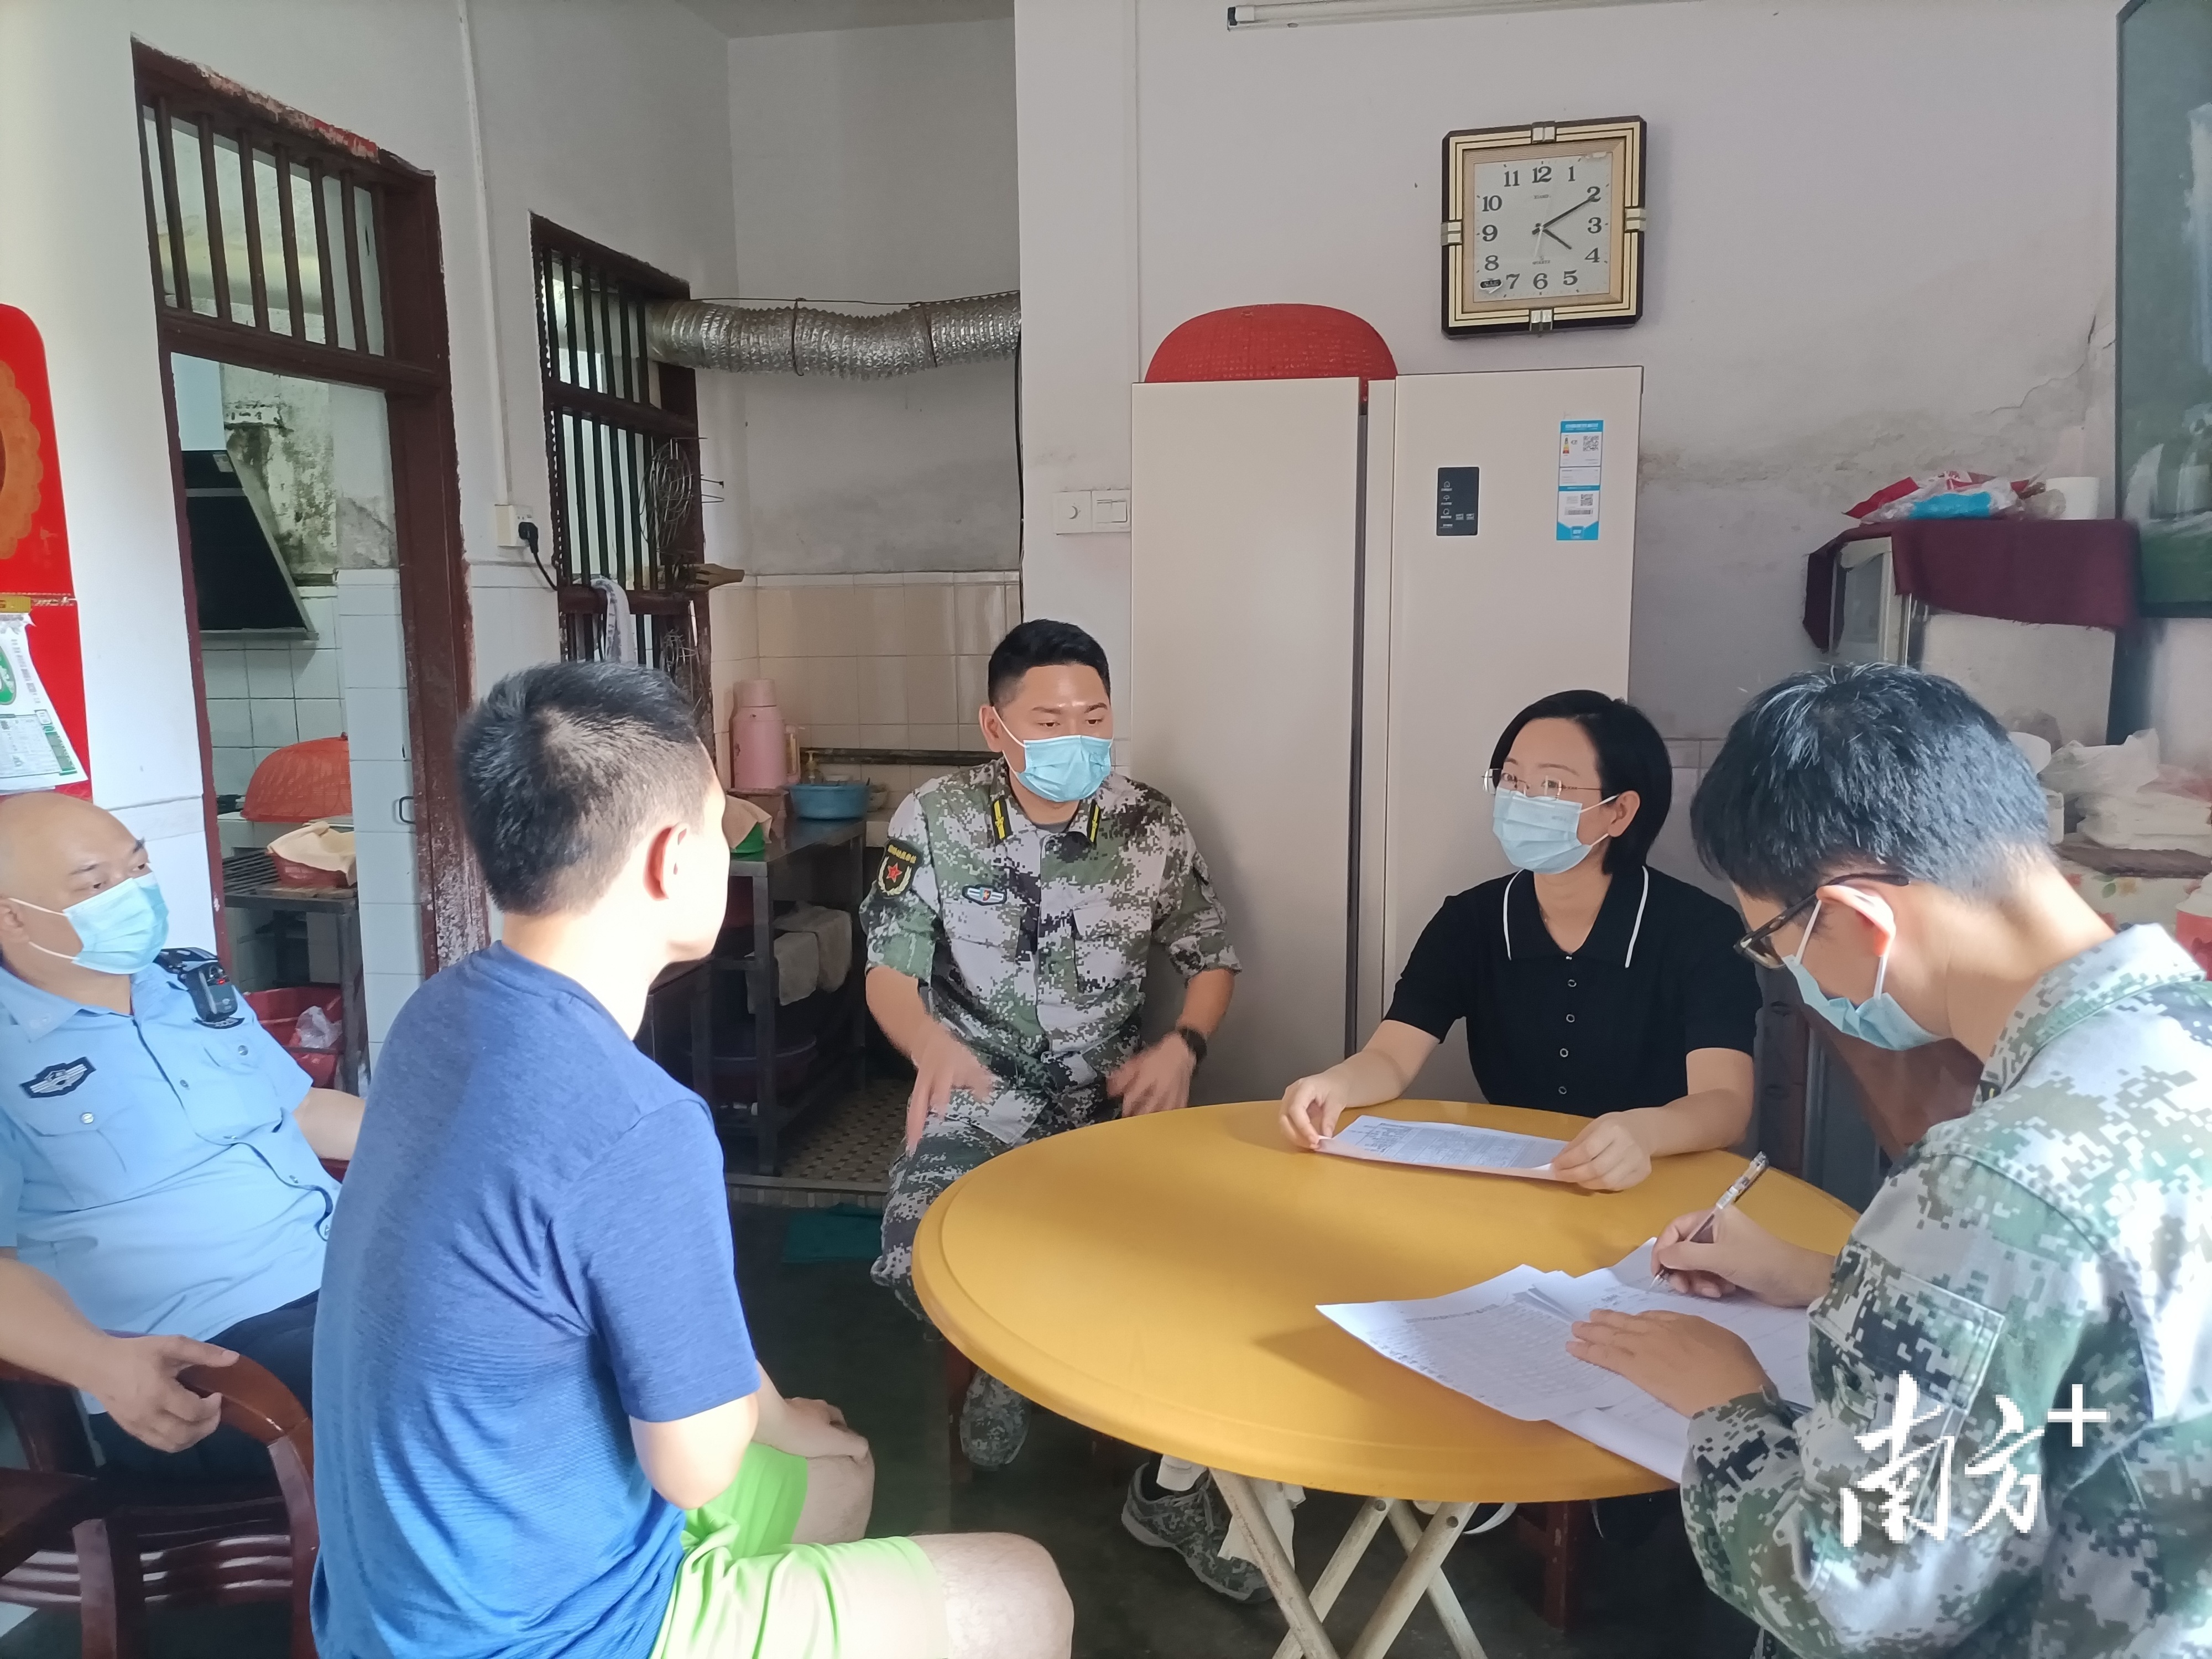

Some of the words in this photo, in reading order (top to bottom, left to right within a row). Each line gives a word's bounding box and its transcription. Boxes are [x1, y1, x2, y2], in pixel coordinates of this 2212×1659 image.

[1504, 170, 1520, 187] 11
[1532, 166, 1551, 183] 12
[1568, 165, 1575, 181] 1
[1587, 186, 1601, 202] 2
[1482, 195, 1502, 211] 10
[1587, 217, 1601, 233] 3
[1482, 225, 1498, 242] 9
[1484, 255, 1499, 270] 8
[1584, 247, 1599, 263] 4
[1506, 273, 1520, 289] 7
[1532, 273, 1548, 289] 6
[1563, 269, 1578, 285] 5
